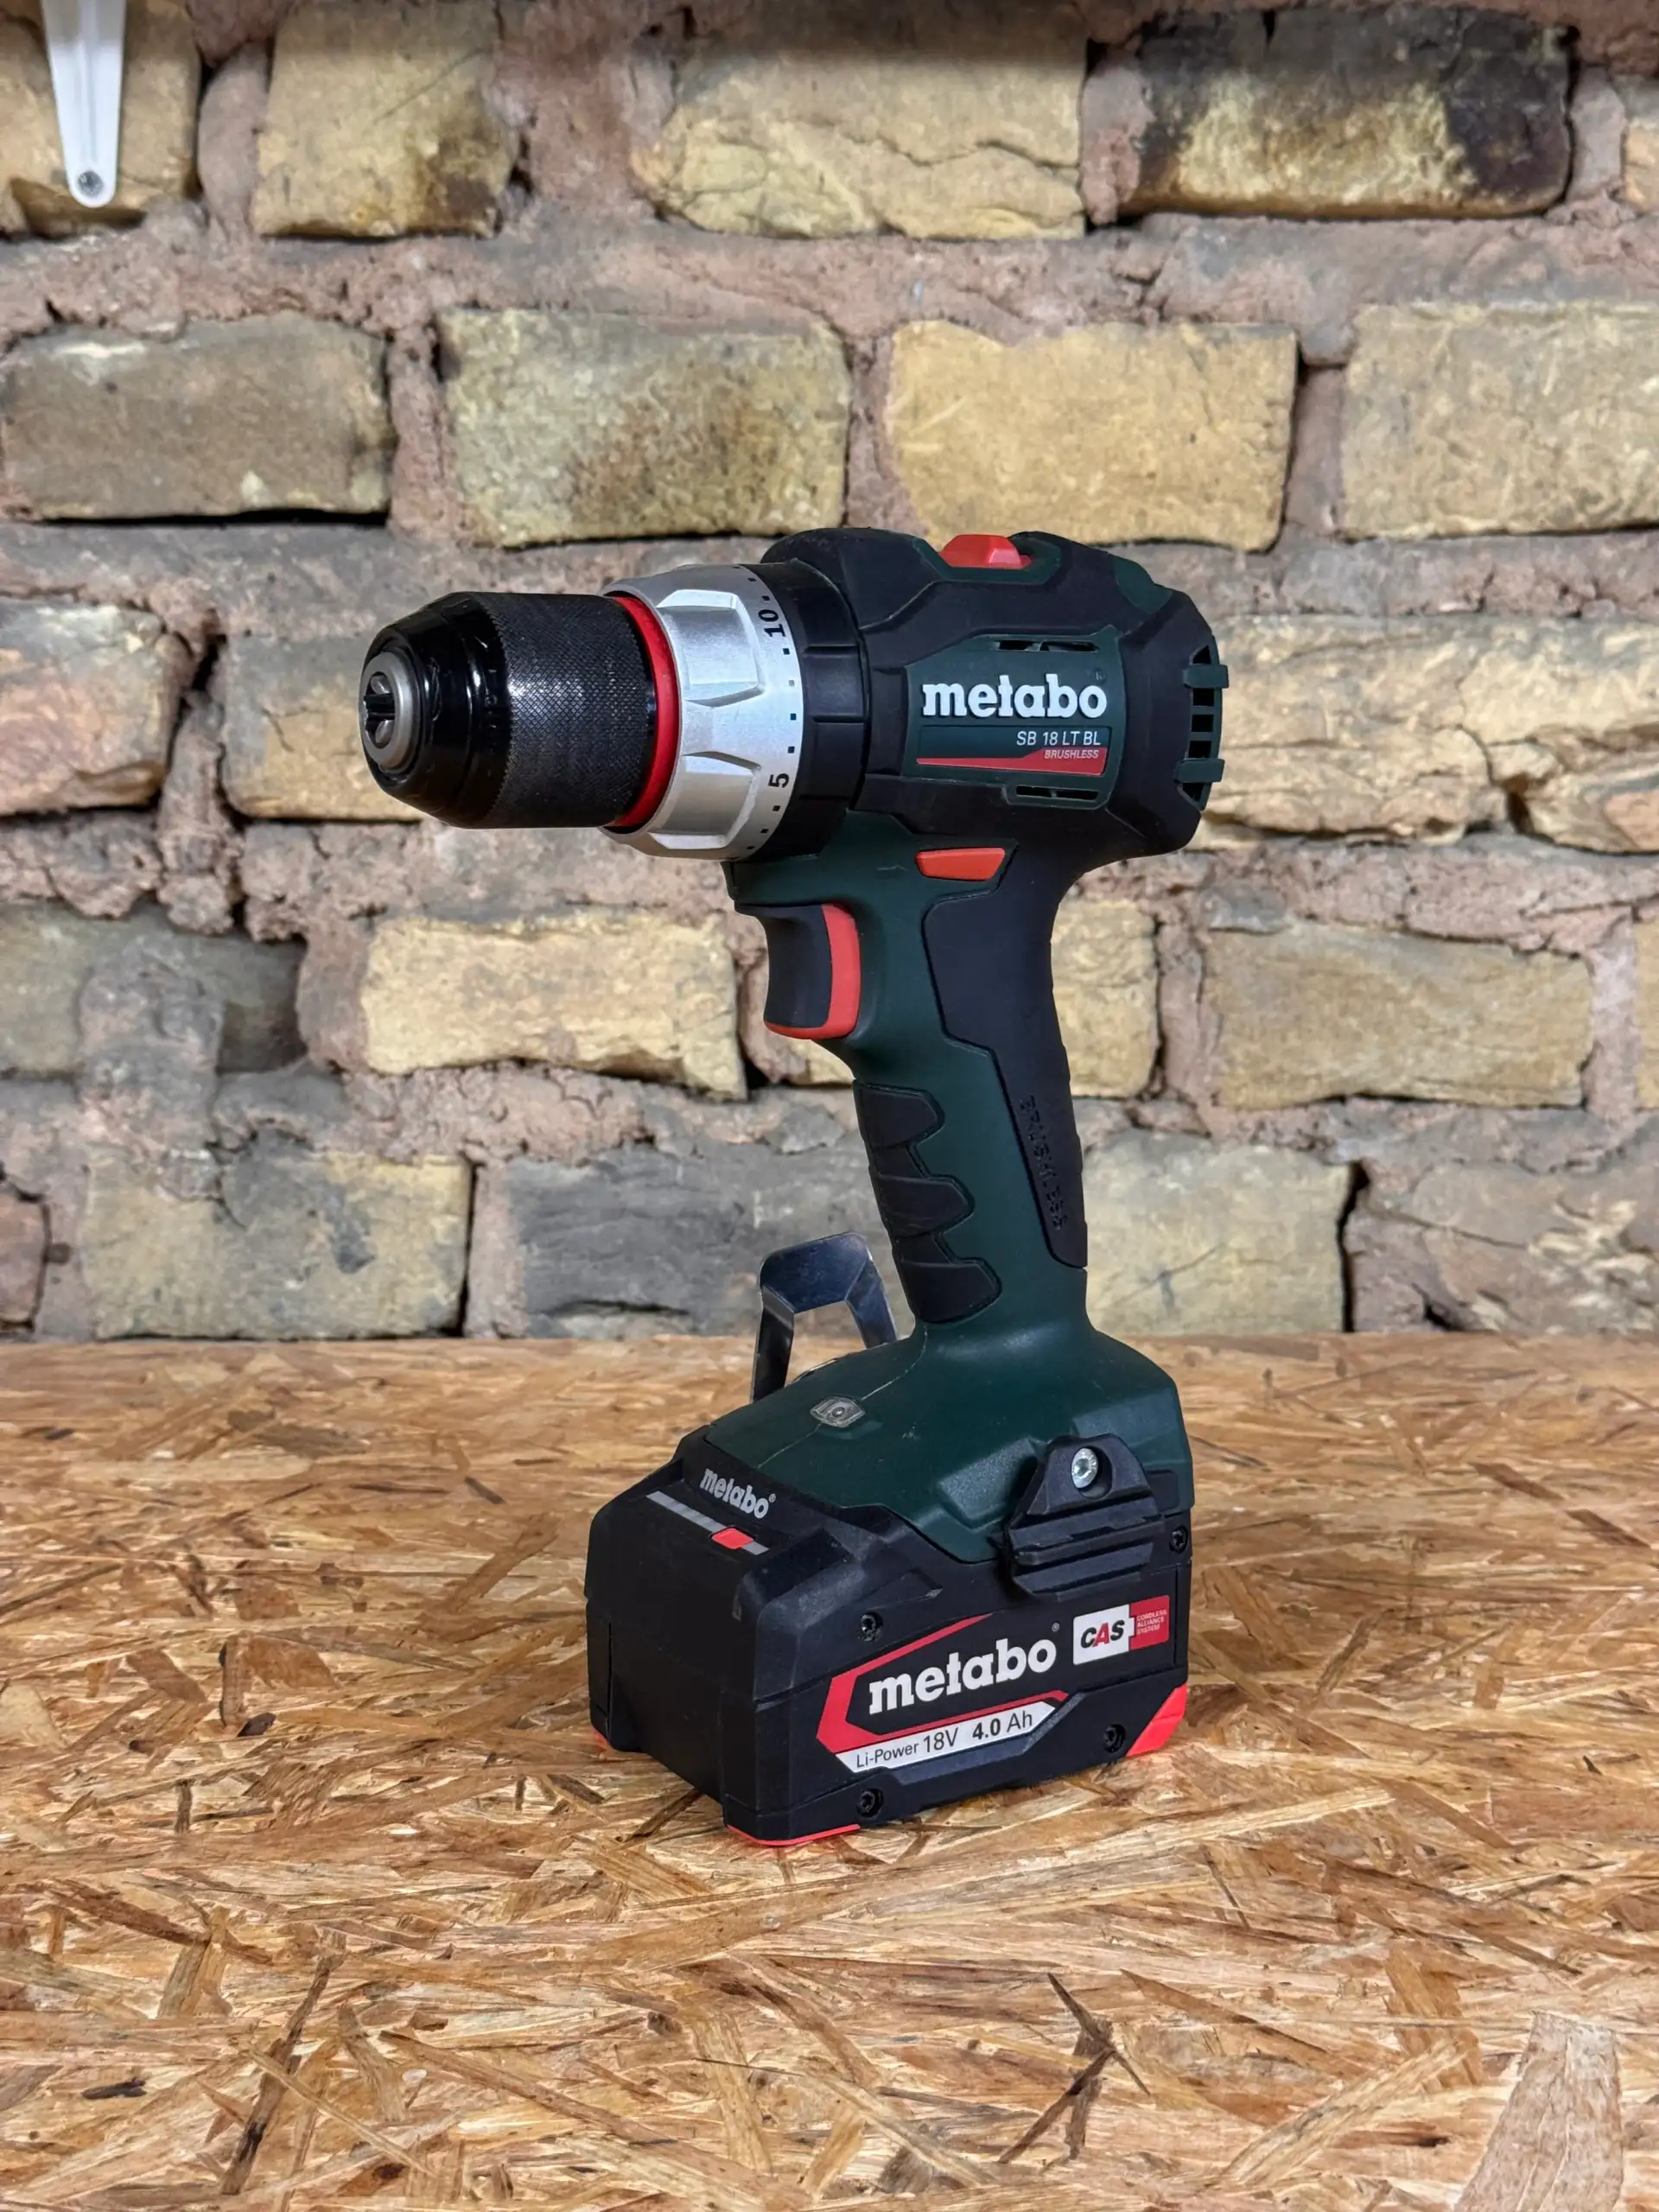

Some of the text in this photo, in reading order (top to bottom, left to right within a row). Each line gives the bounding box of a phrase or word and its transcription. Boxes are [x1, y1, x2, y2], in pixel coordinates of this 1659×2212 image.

[758, 608, 787, 639] 10
[922, 673, 1108, 719] metabo
[1016, 730, 1101, 746] SB 18 LT BL
[1044, 749, 1100, 760] BRUSHLESS
[768, 772, 790, 789] 5
[699, 1467, 769, 1519] metabo
[1080, 1619, 1125, 1649] CAS
[868, 1637, 1057, 1715] metabo
[856, 1710, 1033, 1768] Li-Power 18V 4.0 Ah
